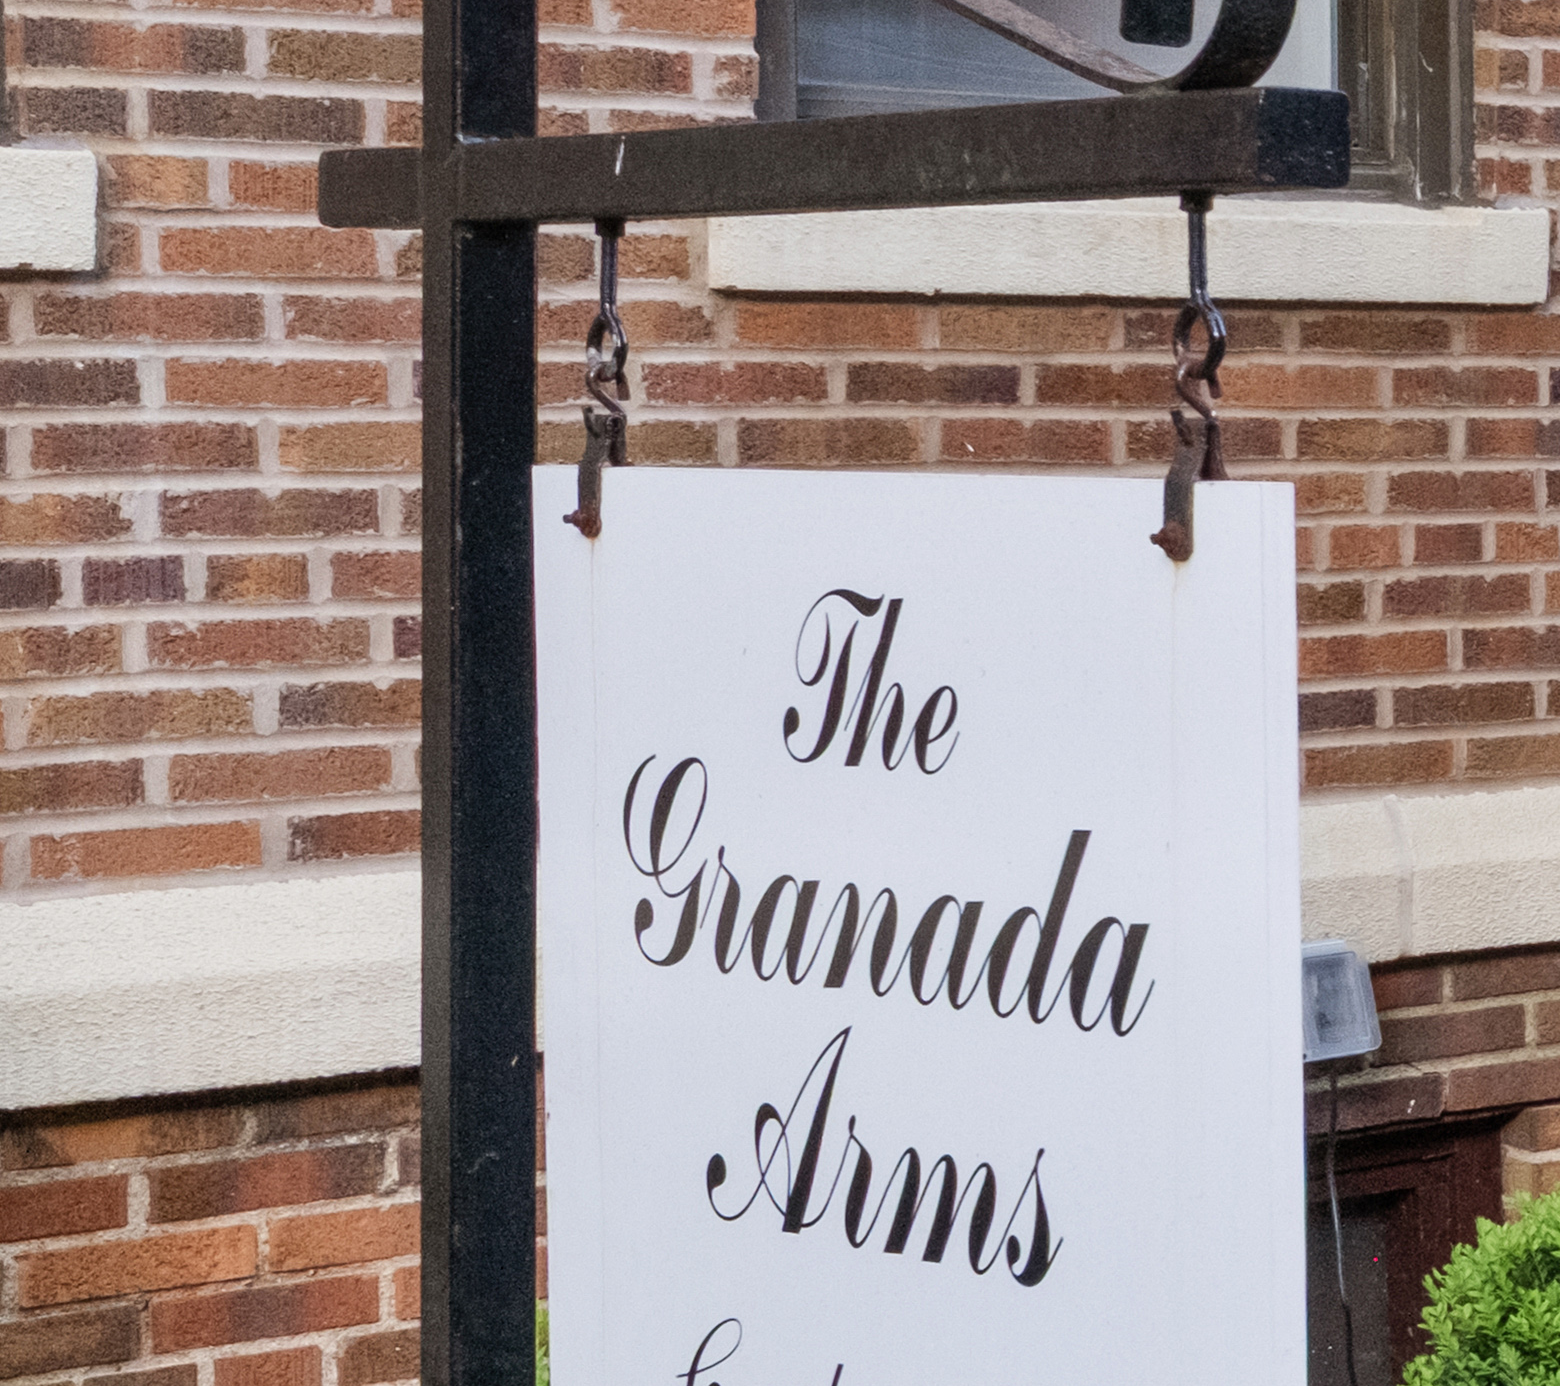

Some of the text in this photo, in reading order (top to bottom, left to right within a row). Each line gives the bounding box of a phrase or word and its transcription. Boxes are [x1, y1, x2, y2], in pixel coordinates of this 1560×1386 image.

[782, 587, 960, 776] The
[621, 753, 1156, 1039] Granada
[706, 1024, 1065, 1289] Arms
